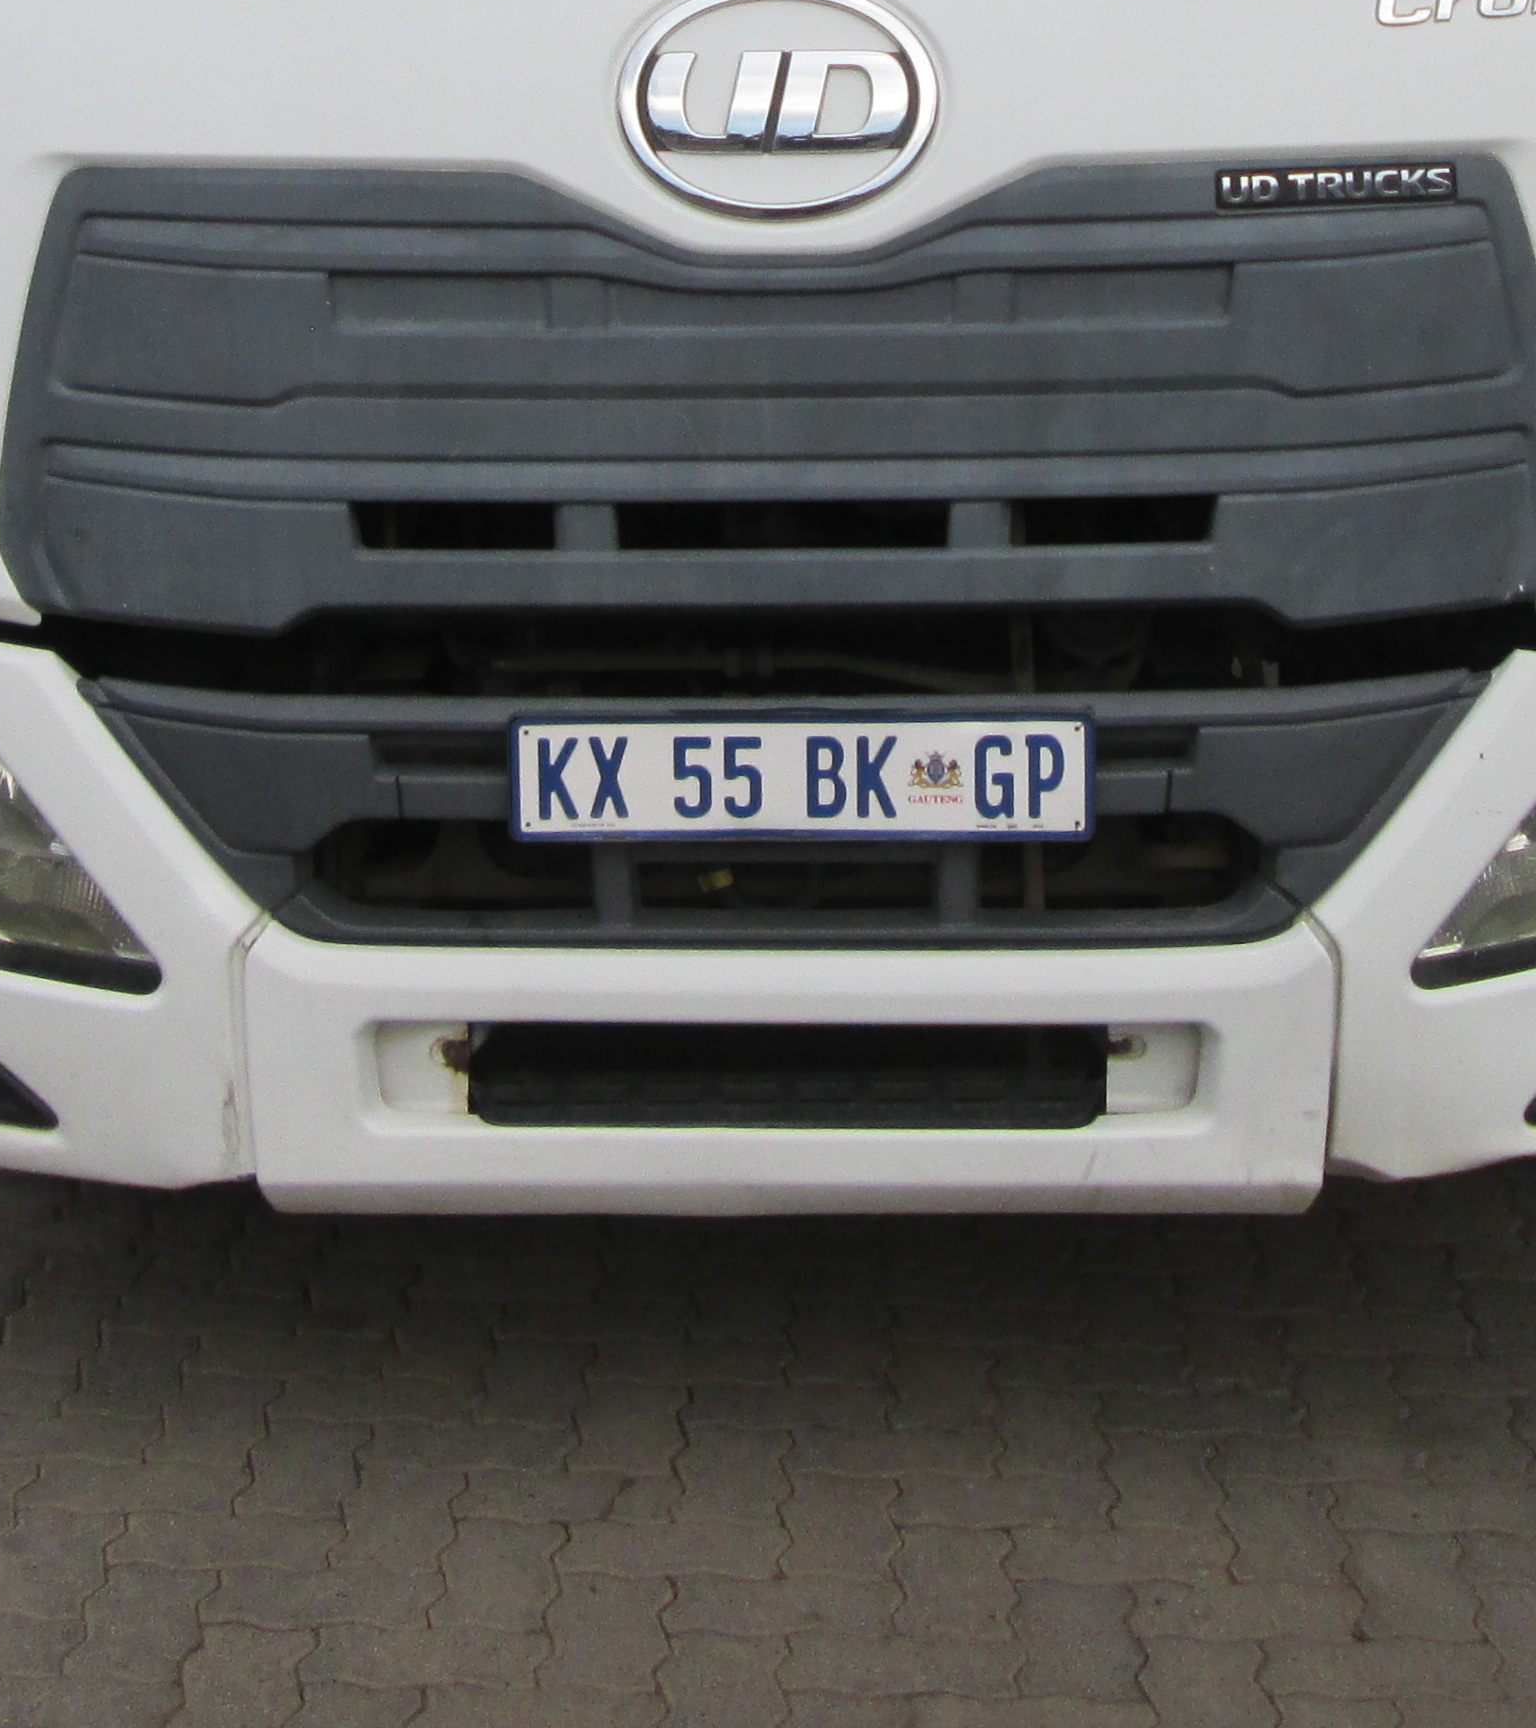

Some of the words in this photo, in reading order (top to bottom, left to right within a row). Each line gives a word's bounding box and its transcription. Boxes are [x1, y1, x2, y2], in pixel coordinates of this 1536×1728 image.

[646, 50, 910, 154] UD
[1221, 174, 1279, 204] UD
[1287, 167, 1453, 200] TRUCKS
[537, 736, 629, 820] KX
[673, 736, 763, 819] 55
[805, 735, 898, 819] BK
[974, 734, 1065, 819] GP
[907, 794, 964, 804] GAUTENG
